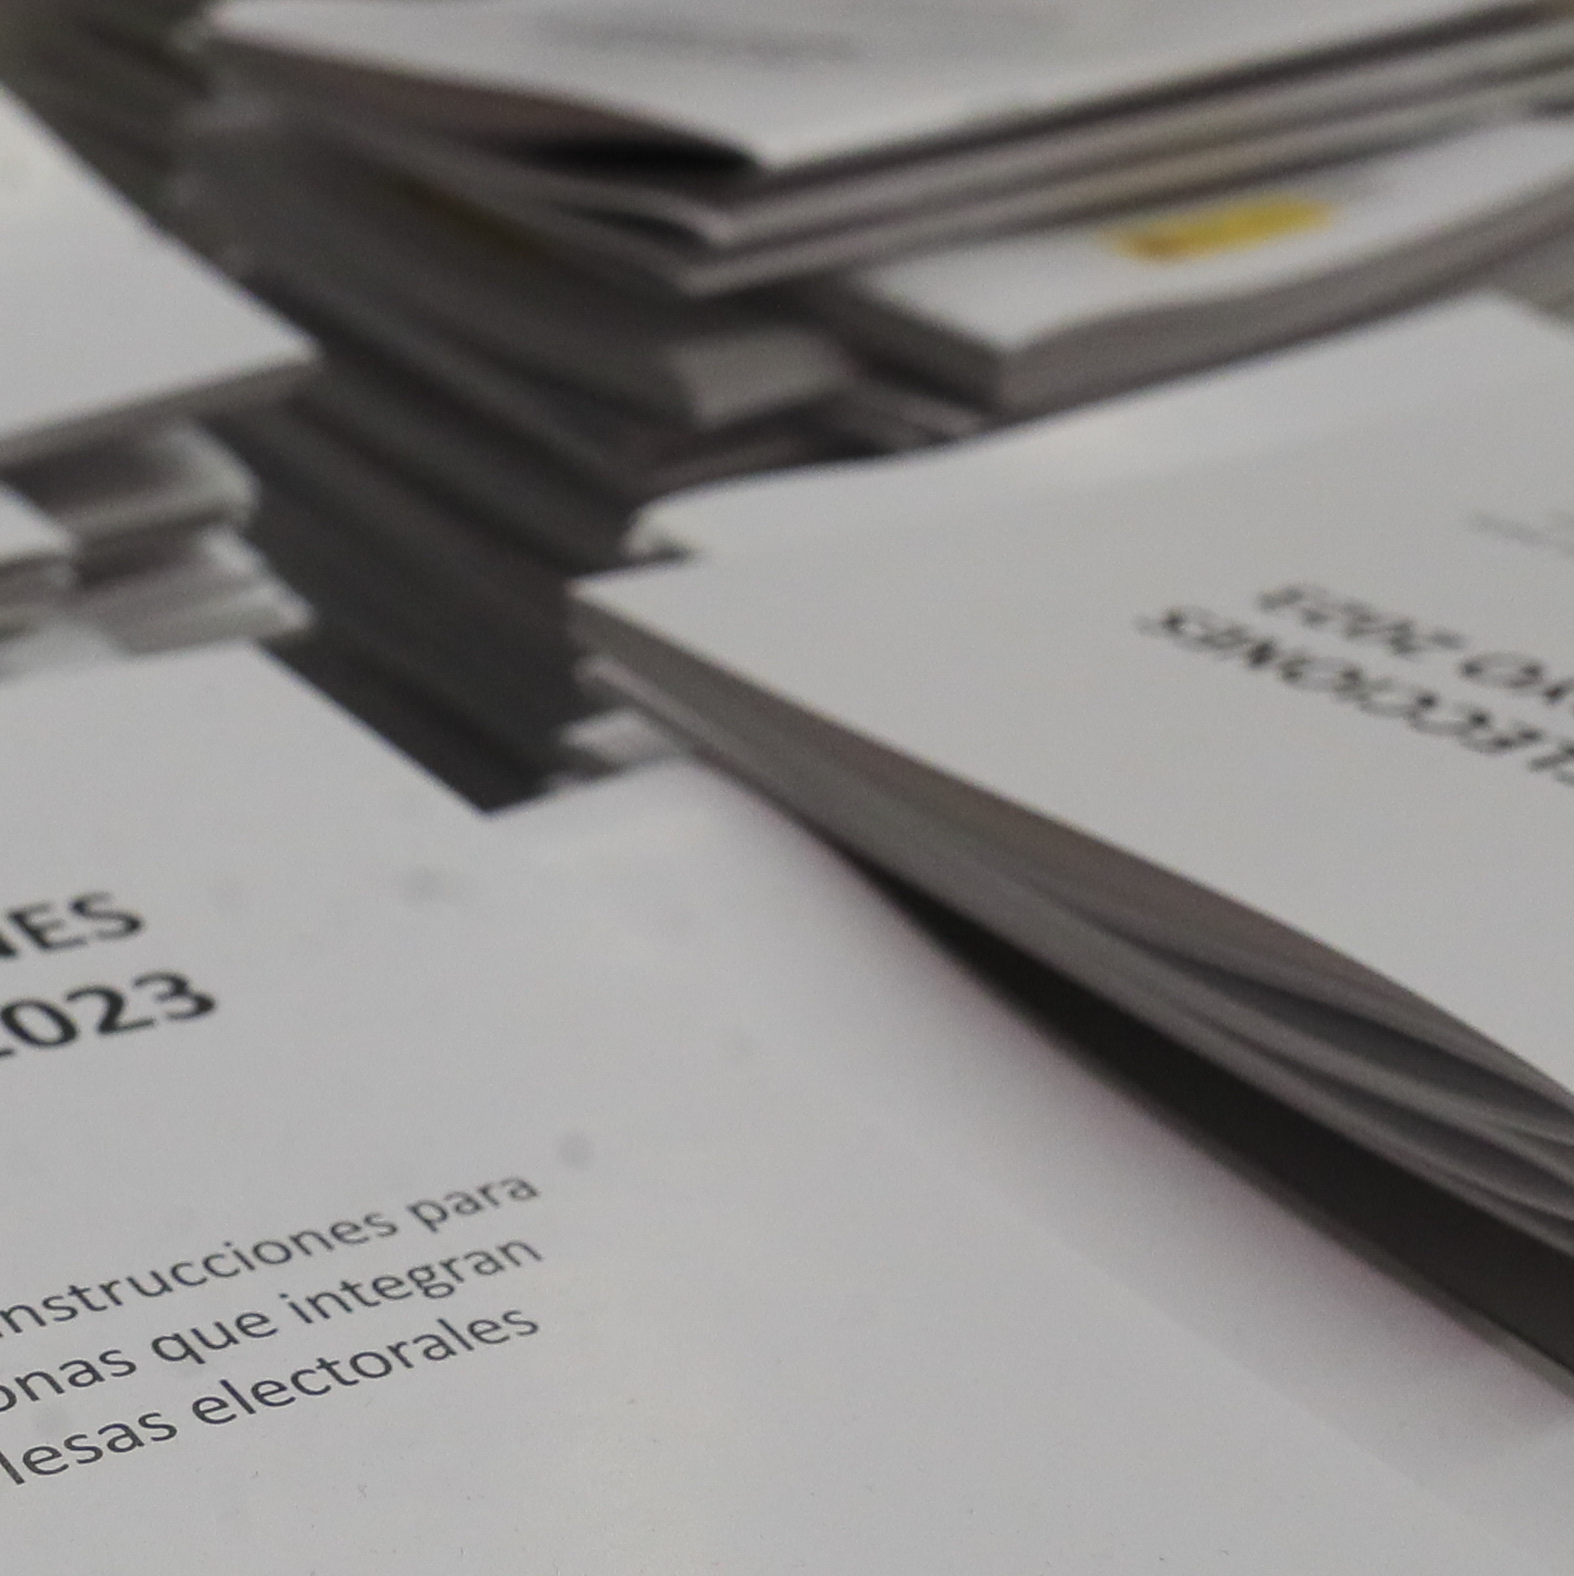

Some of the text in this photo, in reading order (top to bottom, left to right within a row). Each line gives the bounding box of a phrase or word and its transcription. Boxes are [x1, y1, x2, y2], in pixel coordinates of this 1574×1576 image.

[405, 1176, 541, 1235] para
[149, 1310, 280, 1367] que
[278, 1239, 545, 1326] integran
[190, 1308, 541, 1426] electorales
